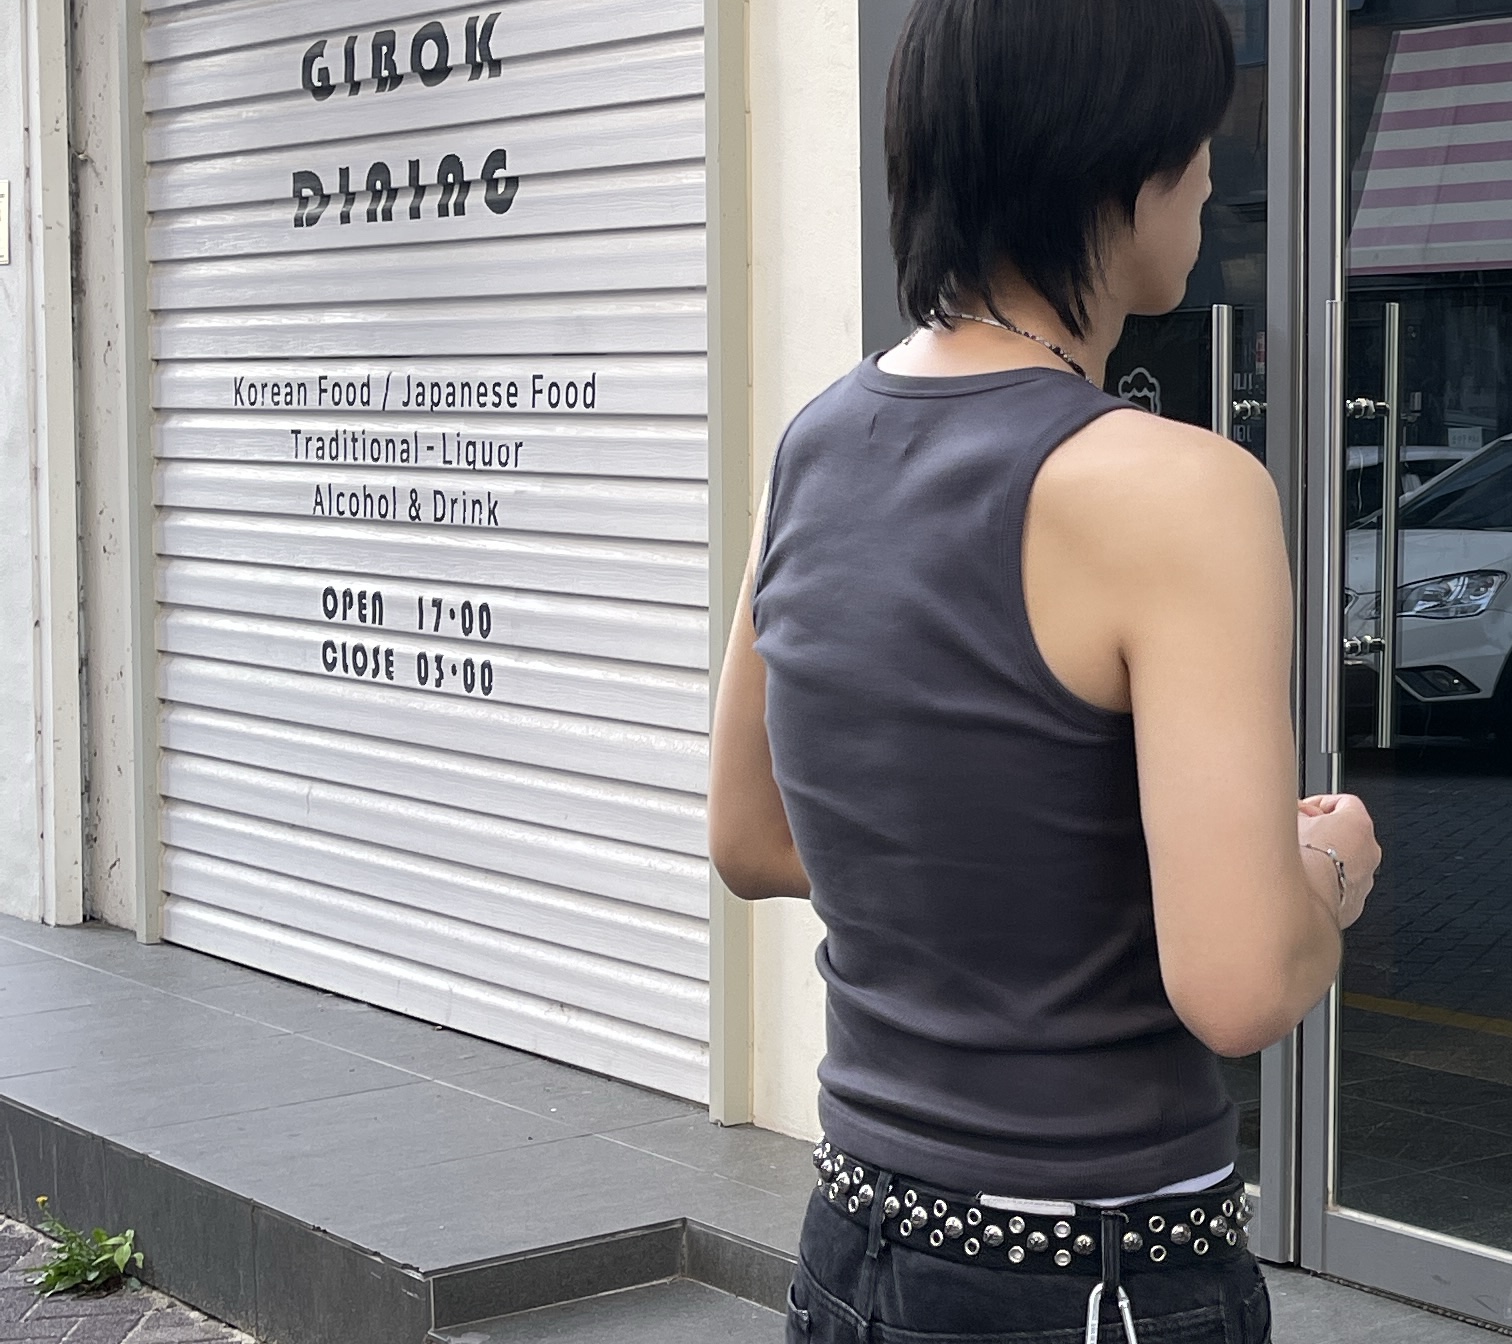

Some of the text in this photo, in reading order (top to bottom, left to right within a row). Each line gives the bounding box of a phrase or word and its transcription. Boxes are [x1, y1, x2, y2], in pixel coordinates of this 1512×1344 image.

[302, 12, 502, 101] GIROK
[293, 149, 519, 228] DINING
[234, 375, 307, 407] Korean
[318, 374, 371, 407] Food
[402, 374, 518, 412] Japanese
[531, 372, 596, 409] Food
[313, 483, 499, 526] Alcohol & Drink
[322, 585, 384, 626] OPEN
[322, 639, 395, 681] CLOSE
